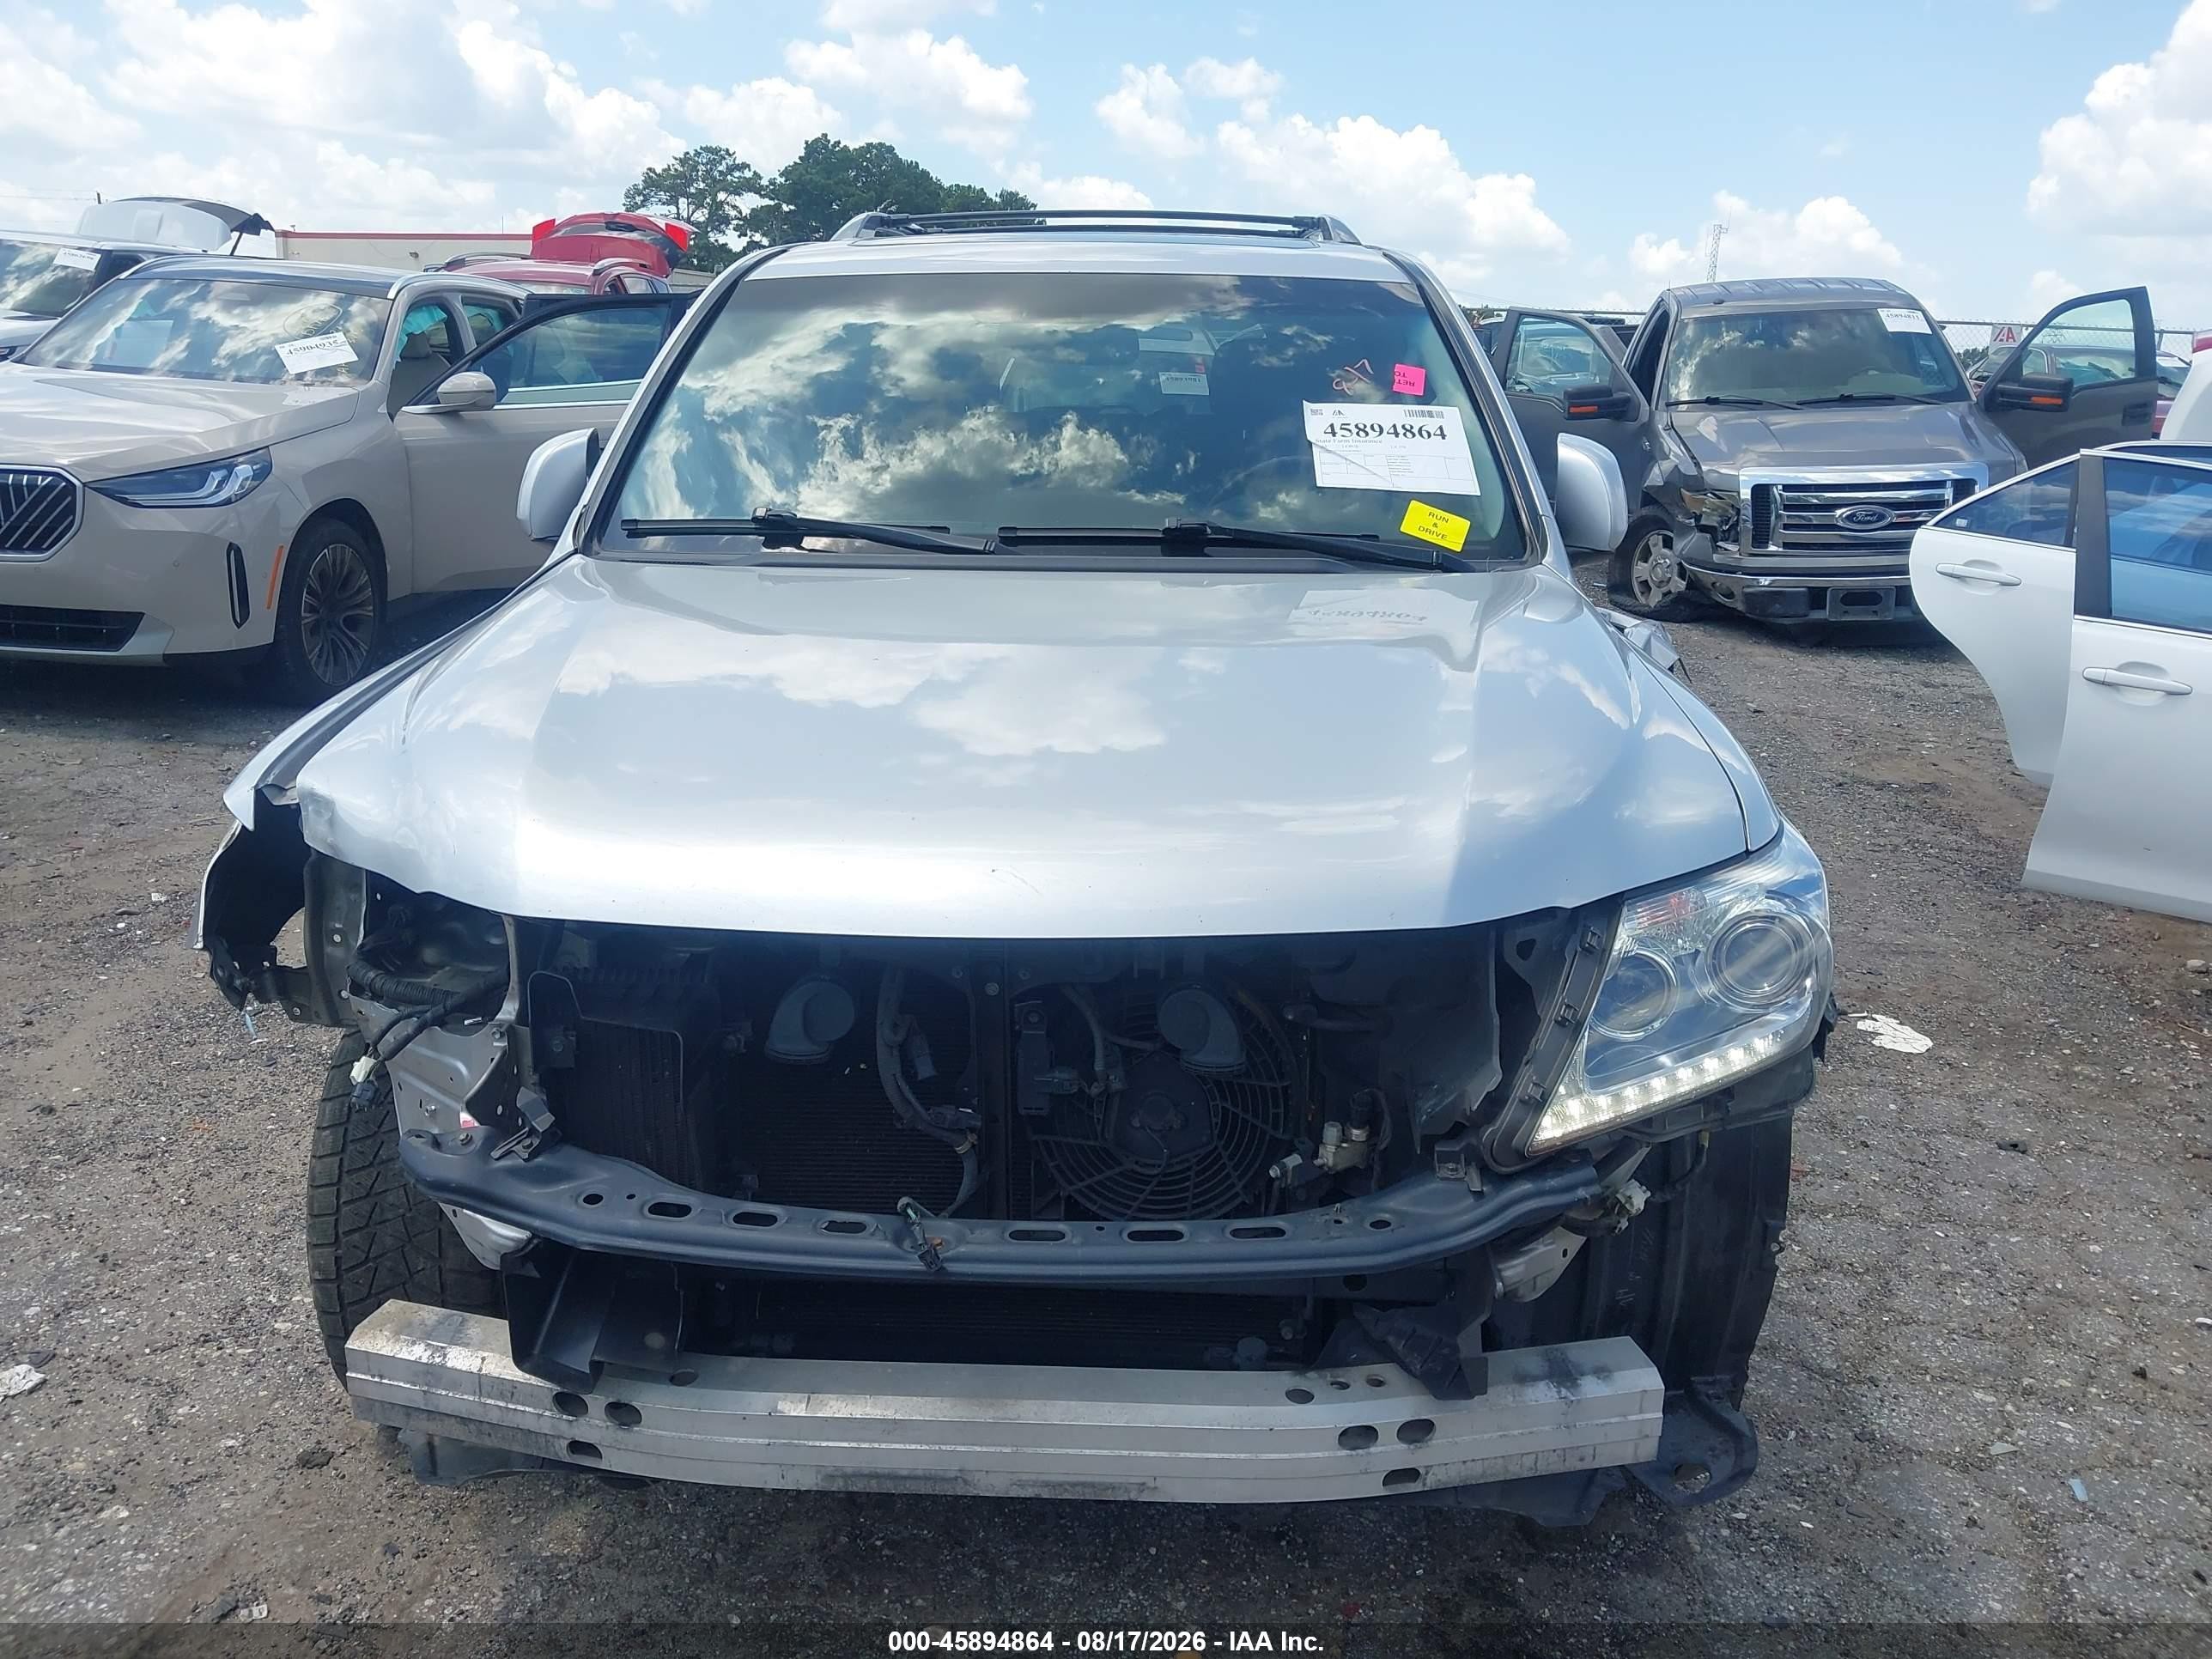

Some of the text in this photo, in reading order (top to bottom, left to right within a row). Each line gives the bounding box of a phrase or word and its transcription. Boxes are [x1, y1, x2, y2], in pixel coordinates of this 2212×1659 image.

[1395, 379, 1415, 387] RET
[1323, 422, 1448, 441] 45894864
[1428, 512, 1449, 523] RUN
[1853, 511, 1879, 522] Ford
[1419, 526, 1448, 539] DRIVE
